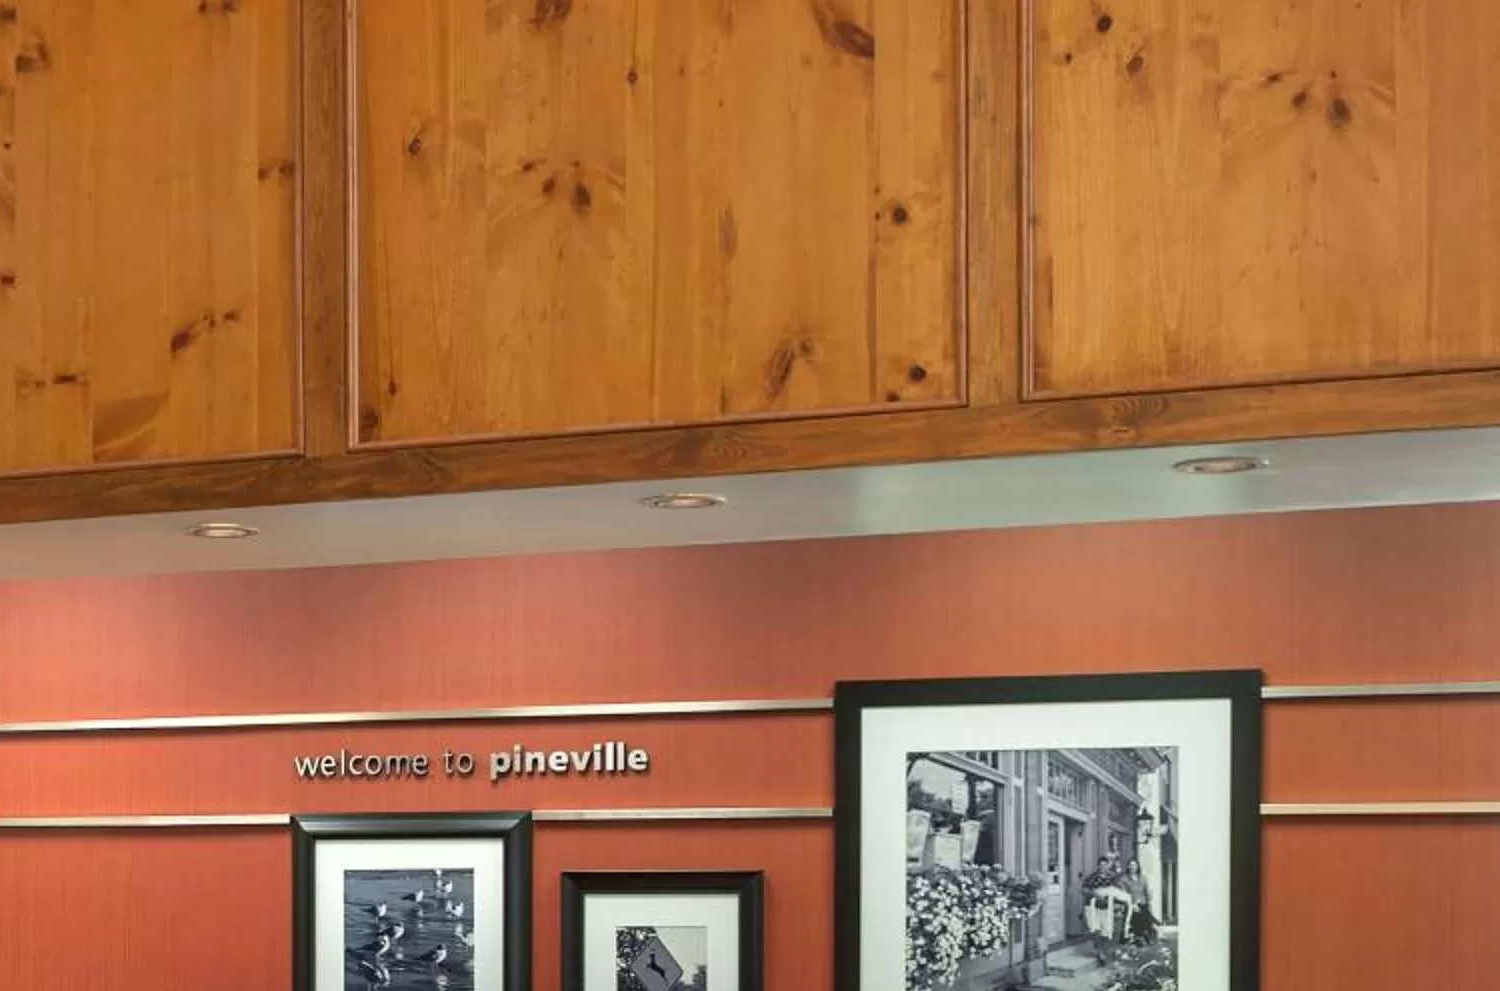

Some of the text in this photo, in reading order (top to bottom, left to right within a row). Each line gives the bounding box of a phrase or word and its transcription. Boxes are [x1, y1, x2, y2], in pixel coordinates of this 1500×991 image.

[294, 741, 650, 781] welcome to pineville
